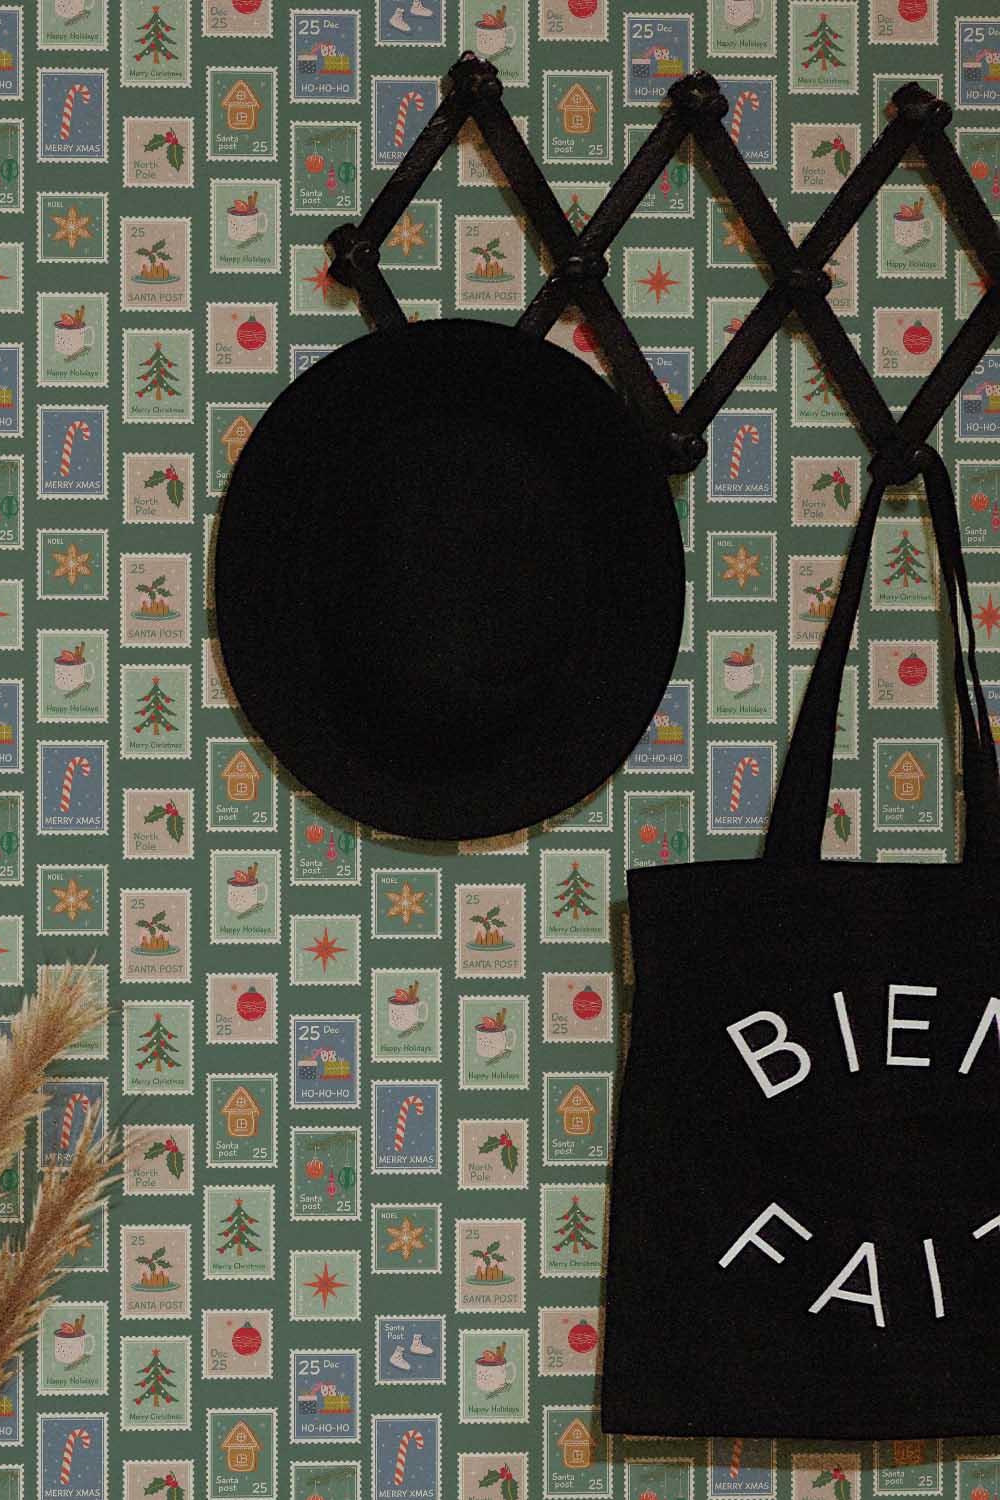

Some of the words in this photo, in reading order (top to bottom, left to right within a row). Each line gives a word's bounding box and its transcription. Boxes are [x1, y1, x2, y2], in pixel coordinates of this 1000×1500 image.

[297, 19, 321, 36] 25
[300, 84, 351, 94] HO-HO-HO
[45, 144, 73, 153] MERRY
[76, 144, 102, 153] XMAS
[252, 141, 268, 152] 25
[45, 480, 73, 489] MERRY
[76, 480, 102, 489] XMAS
[715, 483, 742, 492] MERRY
[745, 483, 770, 492] XMAS
[45, 816, 73, 825] MERRY
[76, 816, 102, 825] XMAS
[297, 1024, 321, 1041] 25
[300, 1089, 351, 1099] HO-HO-HO
[252, 1147, 268, 1158] 25
[379, 1155, 407, 1164] MERRY
[410, 1155, 436, 1164] XMAS
[717, 1202, 1000, 1328] FAI
[297, 1359, 321, 1375] 25
[300, 1422, 350, 1432] HO-HO-HO
[45, 1488, 73, 1497] MERRY
[76, 1488, 102, 1497] XMAS
[379, 1489, 407, 1498] MERRY
[410, 1489, 436, 1498] XMAS
